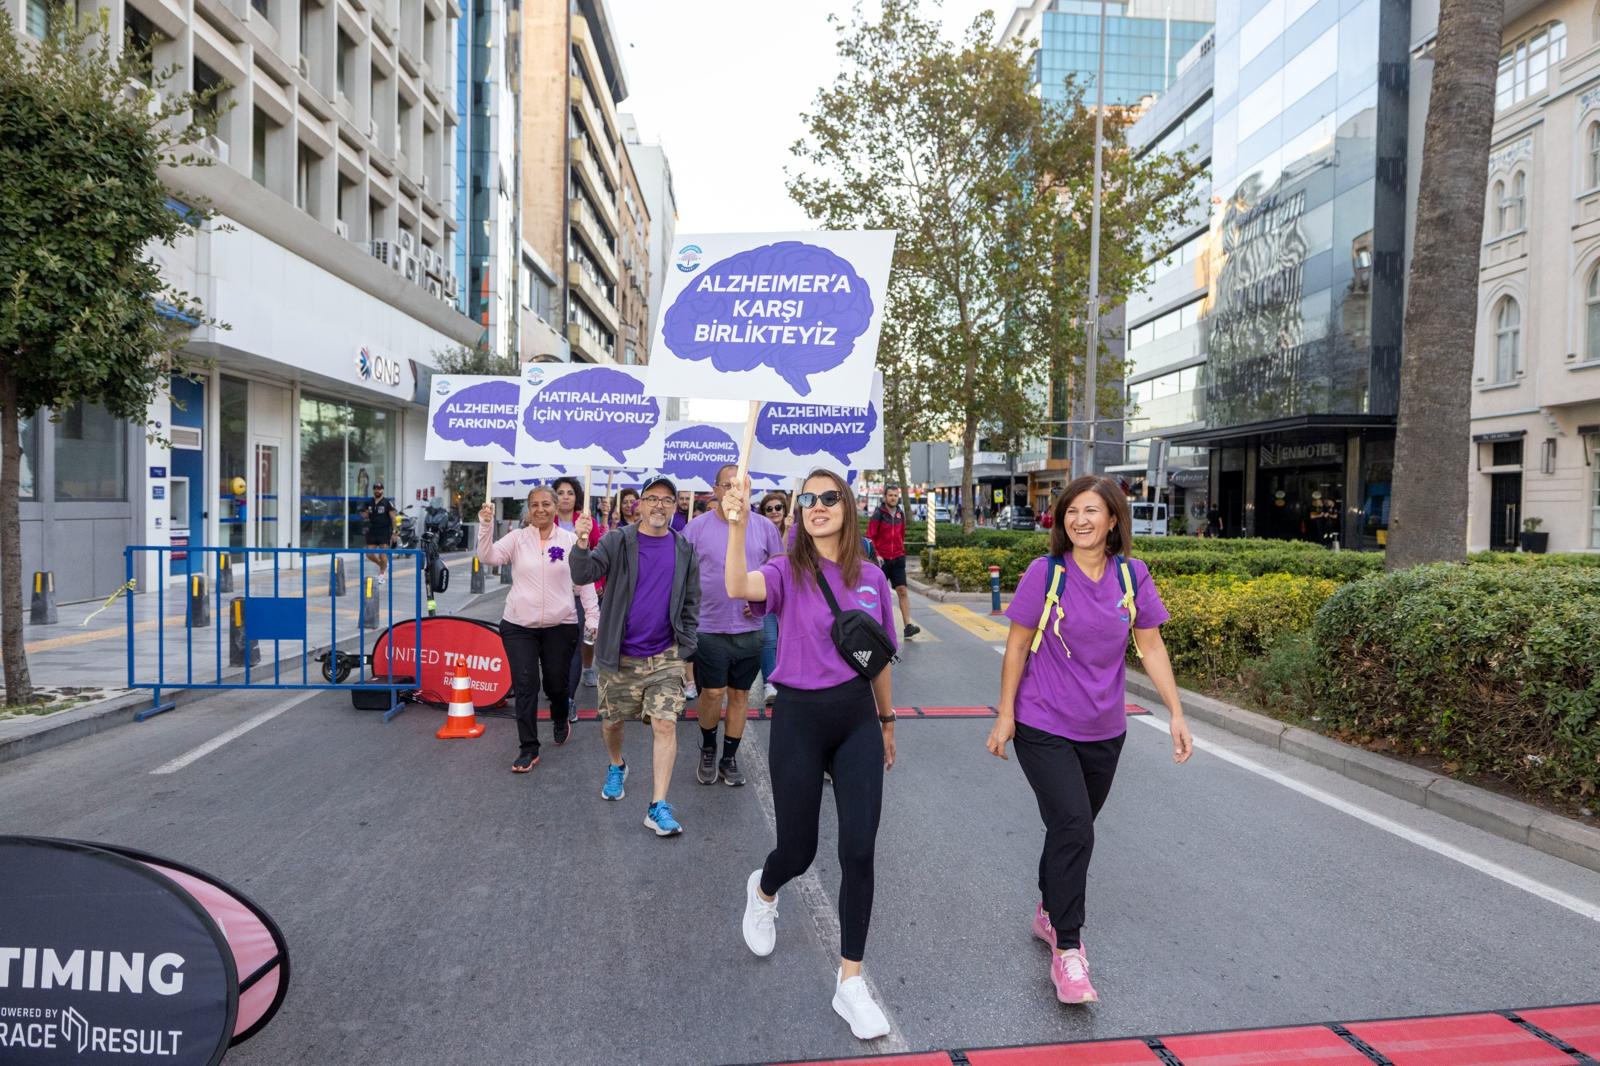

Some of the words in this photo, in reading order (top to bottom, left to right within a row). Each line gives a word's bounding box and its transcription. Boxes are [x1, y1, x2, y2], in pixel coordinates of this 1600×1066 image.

[697, 273, 851, 293] ALZHEIMER'A
[733, 300, 804, 322] KARŞI
[694, 319, 838, 346] BİRLİKTEYİZ
[373, 355, 400, 386] QNB
[539, 391, 651, 406] HATIRALARIMIZ
[533, 406, 561, 424] İÇİN
[564, 406, 655, 424] YÜRÜYORUZ
[771, 422, 865, 436] FARKINDAYIZ
[663, 440, 734, 450] HATIRALARIMIZ
[678, 451, 737, 463] YÜRÜYORUZ
[385, 646, 440, 665] UNITED
[444, 651, 502, 672] TIMING
[470, 680, 499, 692] RESULT
[0, 947, 186, 996] TIMING
[0, 1007, 42, 1018] OWERED
[45, 1008, 58, 1018] BY
[0, 1022, 58, 1048] RACE
[92, 1027, 183, 1055] RESULT
